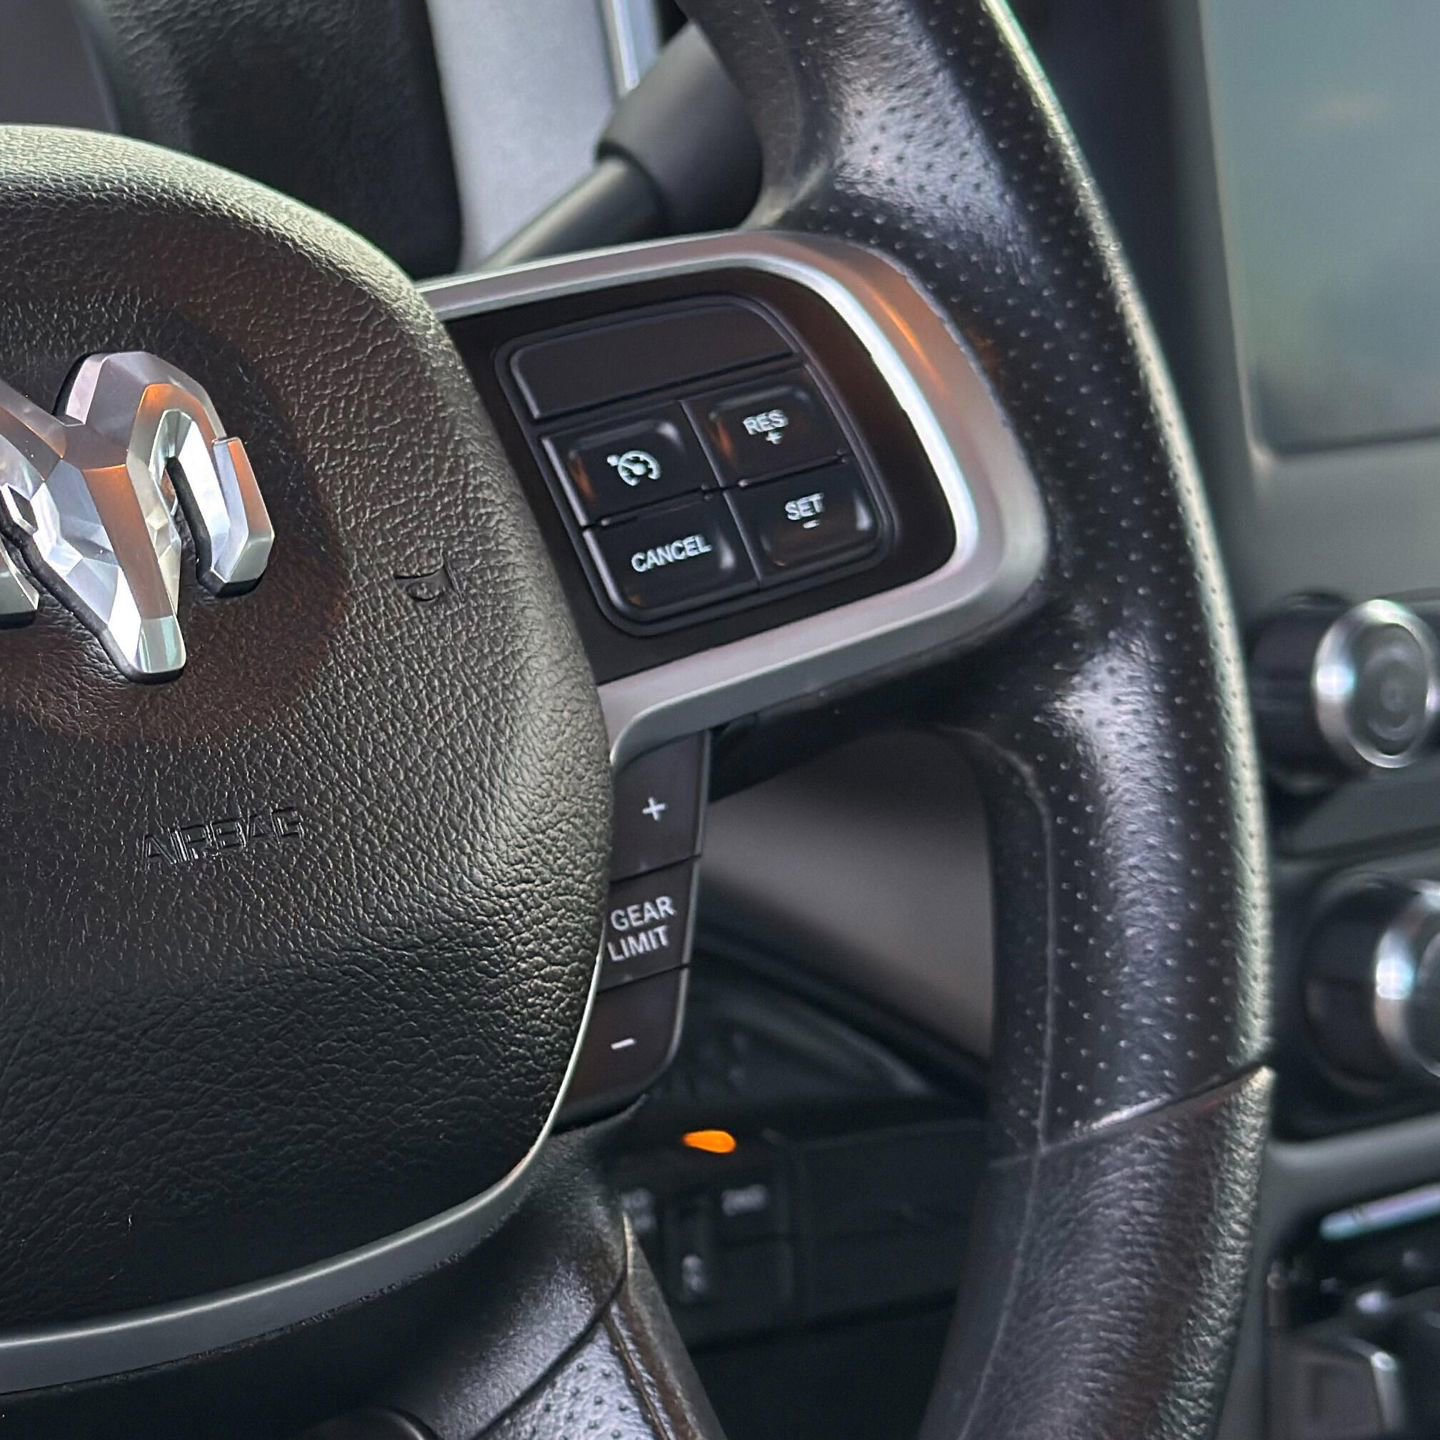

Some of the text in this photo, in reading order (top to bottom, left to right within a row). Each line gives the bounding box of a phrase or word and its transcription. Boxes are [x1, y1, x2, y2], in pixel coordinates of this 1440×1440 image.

[742, 408, 789, 436] RES
[784, 492, 825, 522] SET
[631, 534, 713, 574] CANCEL
[610, 895, 676, 932] GEAR
[607, 926, 671, 962] LIMIT
